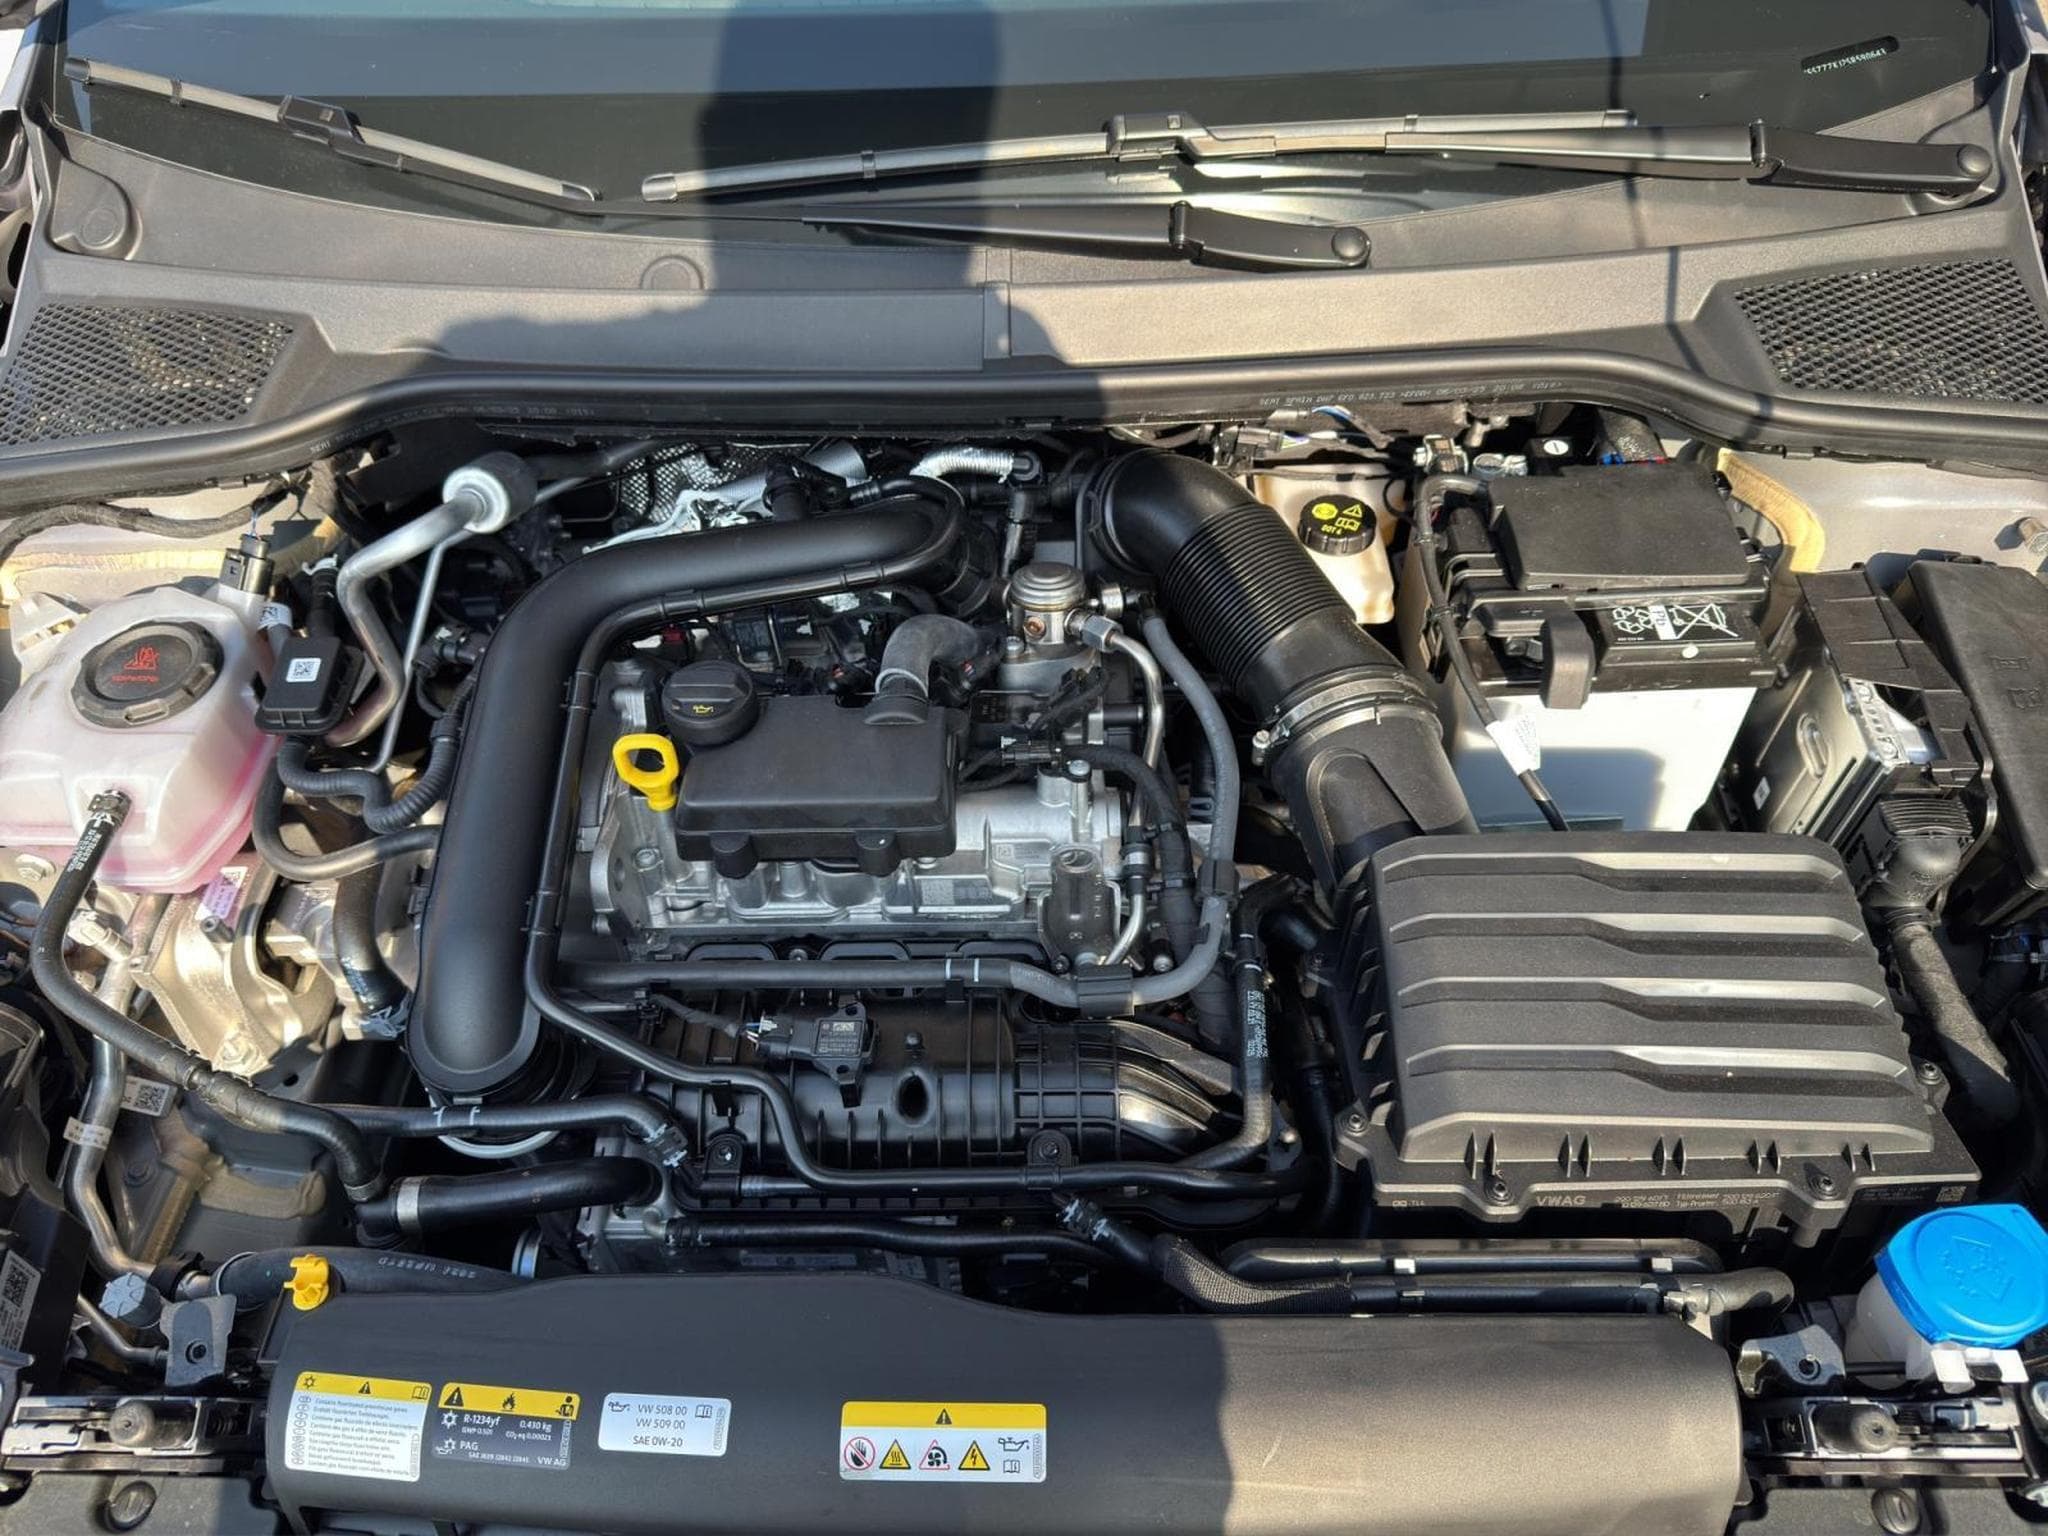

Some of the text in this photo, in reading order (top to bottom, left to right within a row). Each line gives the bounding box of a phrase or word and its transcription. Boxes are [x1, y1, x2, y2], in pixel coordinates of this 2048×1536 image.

[1321, 524, 1337, 534] DOT
[1536, 1195, 1586, 1207] VWAG
[638, 1404, 688, 1415] VW 508 00
[463, 1413, 501, 1428] R-1234yf
[542, 1422, 552, 1433] kg
[636, 1418, 686, 1429] VW 509 00
[460, 1441, 478, 1451] PAG
[633, 1435, 683, 1447] SAE 0W-20
[538, 1457, 552, 1465] VW
[553, 1458, 566, 1467] AG
